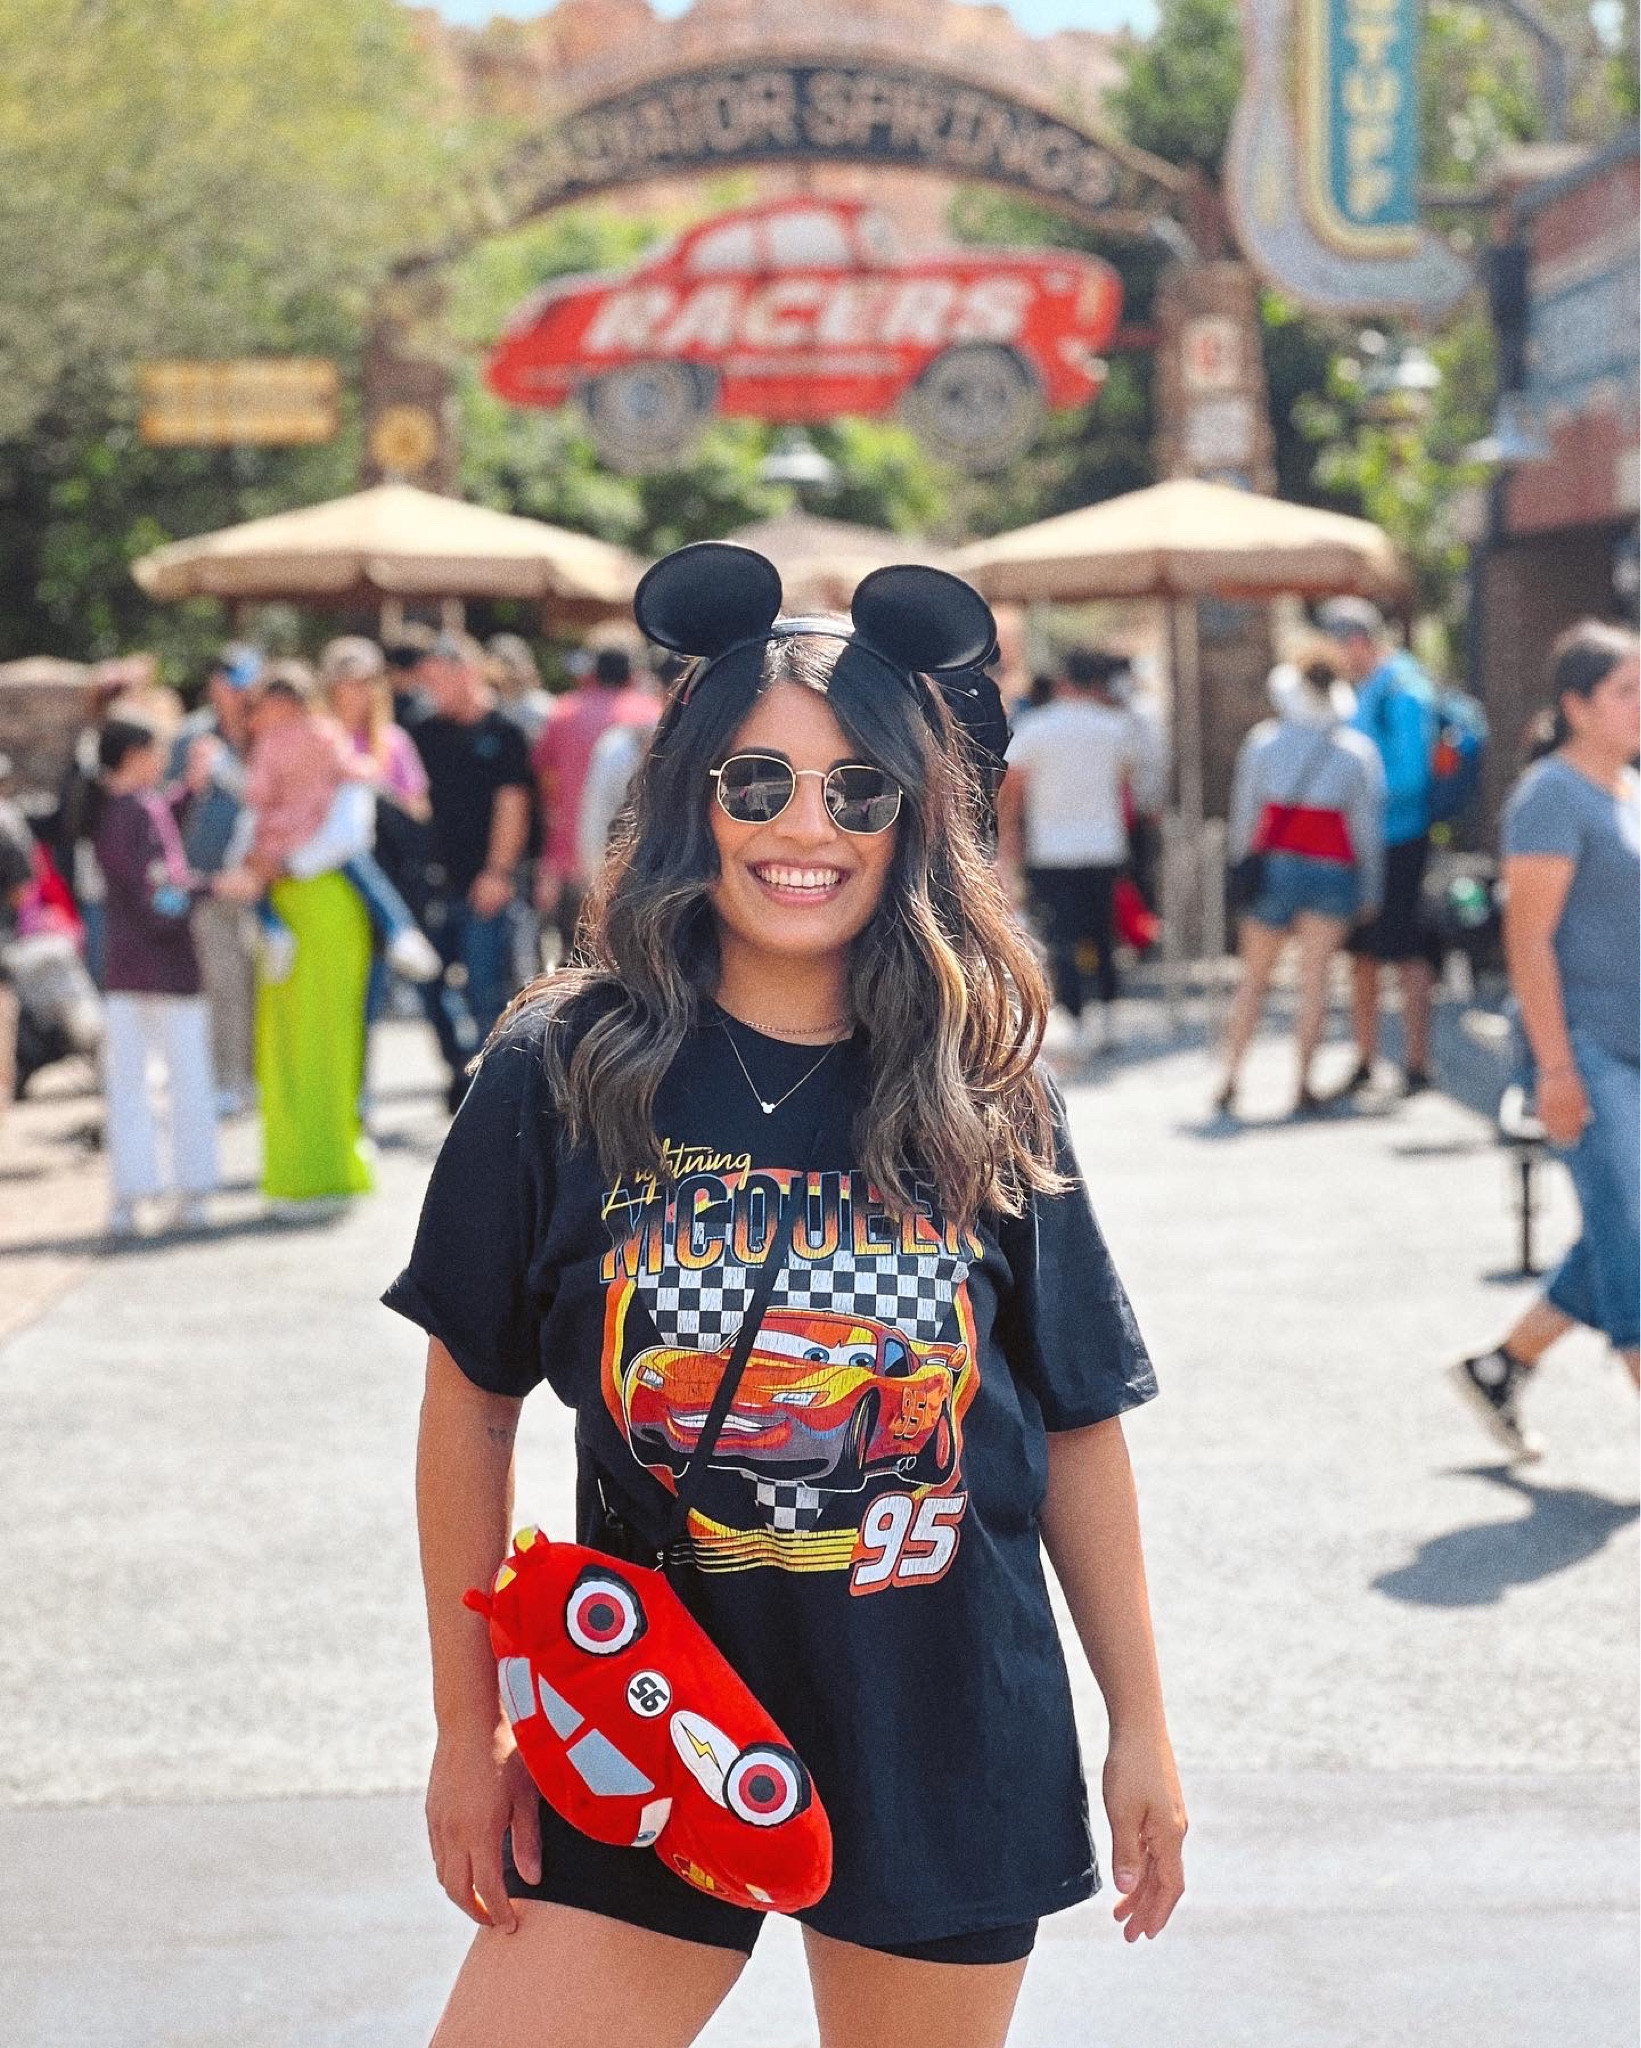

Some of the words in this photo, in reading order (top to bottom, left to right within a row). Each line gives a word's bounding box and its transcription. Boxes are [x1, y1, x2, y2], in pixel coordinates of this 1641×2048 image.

[805, 70, 1117, 206] SPRINGS
[581, 277, 1036, 354] RACERS
[893, 1386, 927, 1440] 95
[850, 1491, 968, 1597] 95
[629, 1676, 668, 1712] 95
